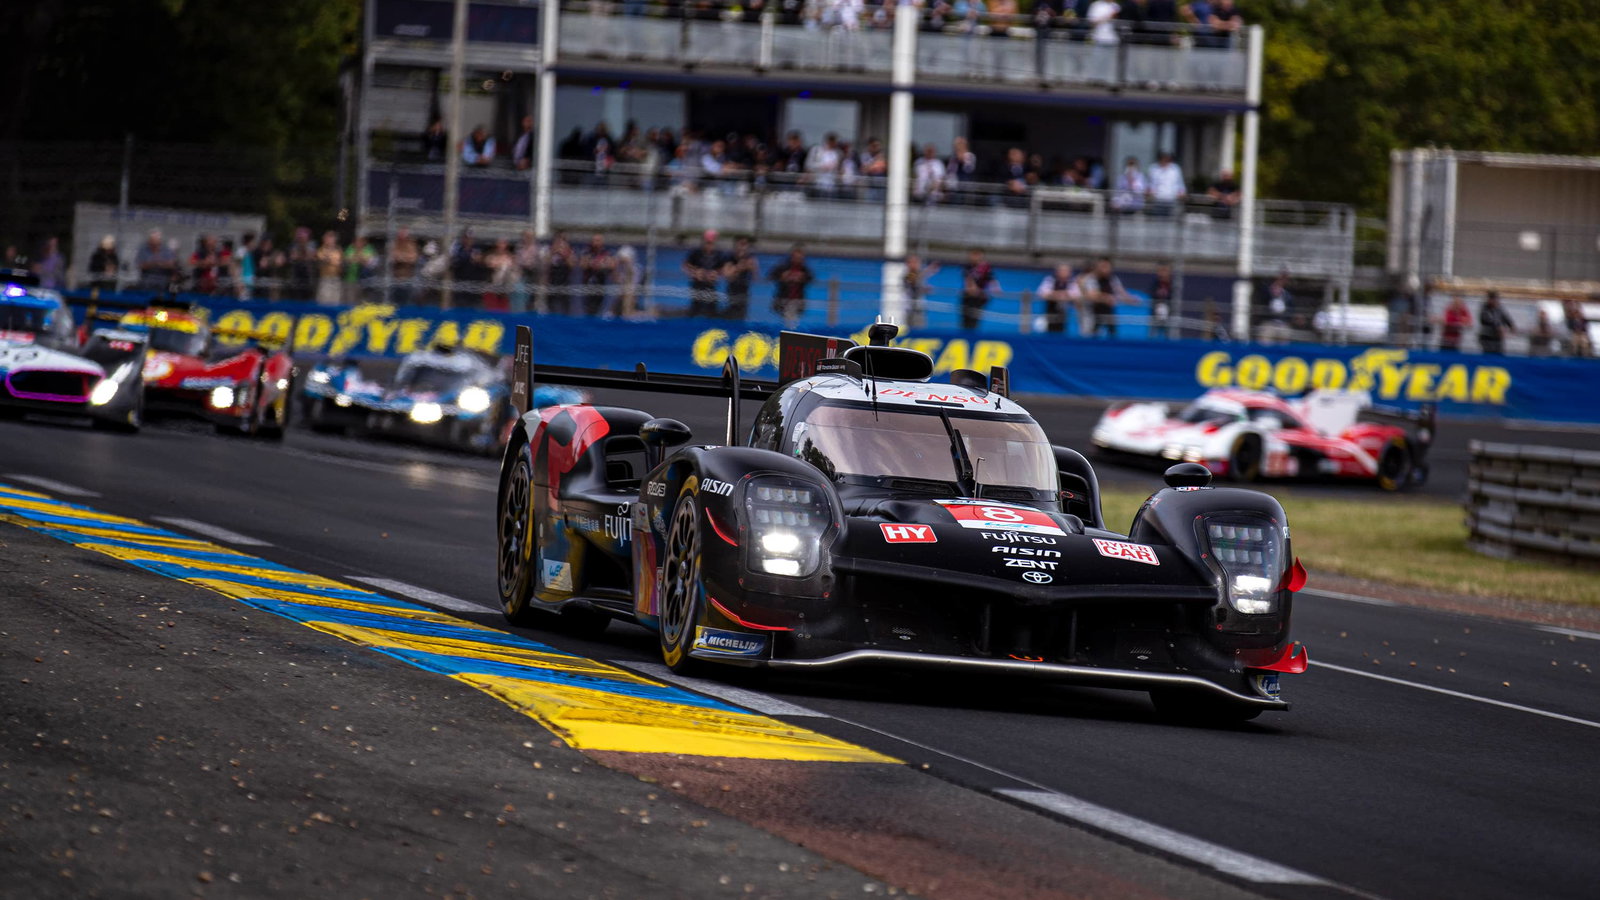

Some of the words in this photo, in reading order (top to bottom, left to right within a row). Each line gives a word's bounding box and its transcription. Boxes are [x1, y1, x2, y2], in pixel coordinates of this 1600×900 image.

[194, 303, 504, 357] OODYEAR
[1195, 348, 1512, 404] GOODYEAR
[879, 388, 989, 405] DENSO
[700, 478, 734, 497] AISIN
[980, 506, 1024, 522] 8
[885, 526, 929, 540] HY
[980, 531, 1057, 546] FUJITSU
[991, 545, 1062, 558] AISIN
[1099, 540, 1149, 553] HYPER
[1102, 545, 1154, 562] CAR
[1003, 557, 1058, 571] ZENT
[708, 635, 758, 651] MICHELIN
